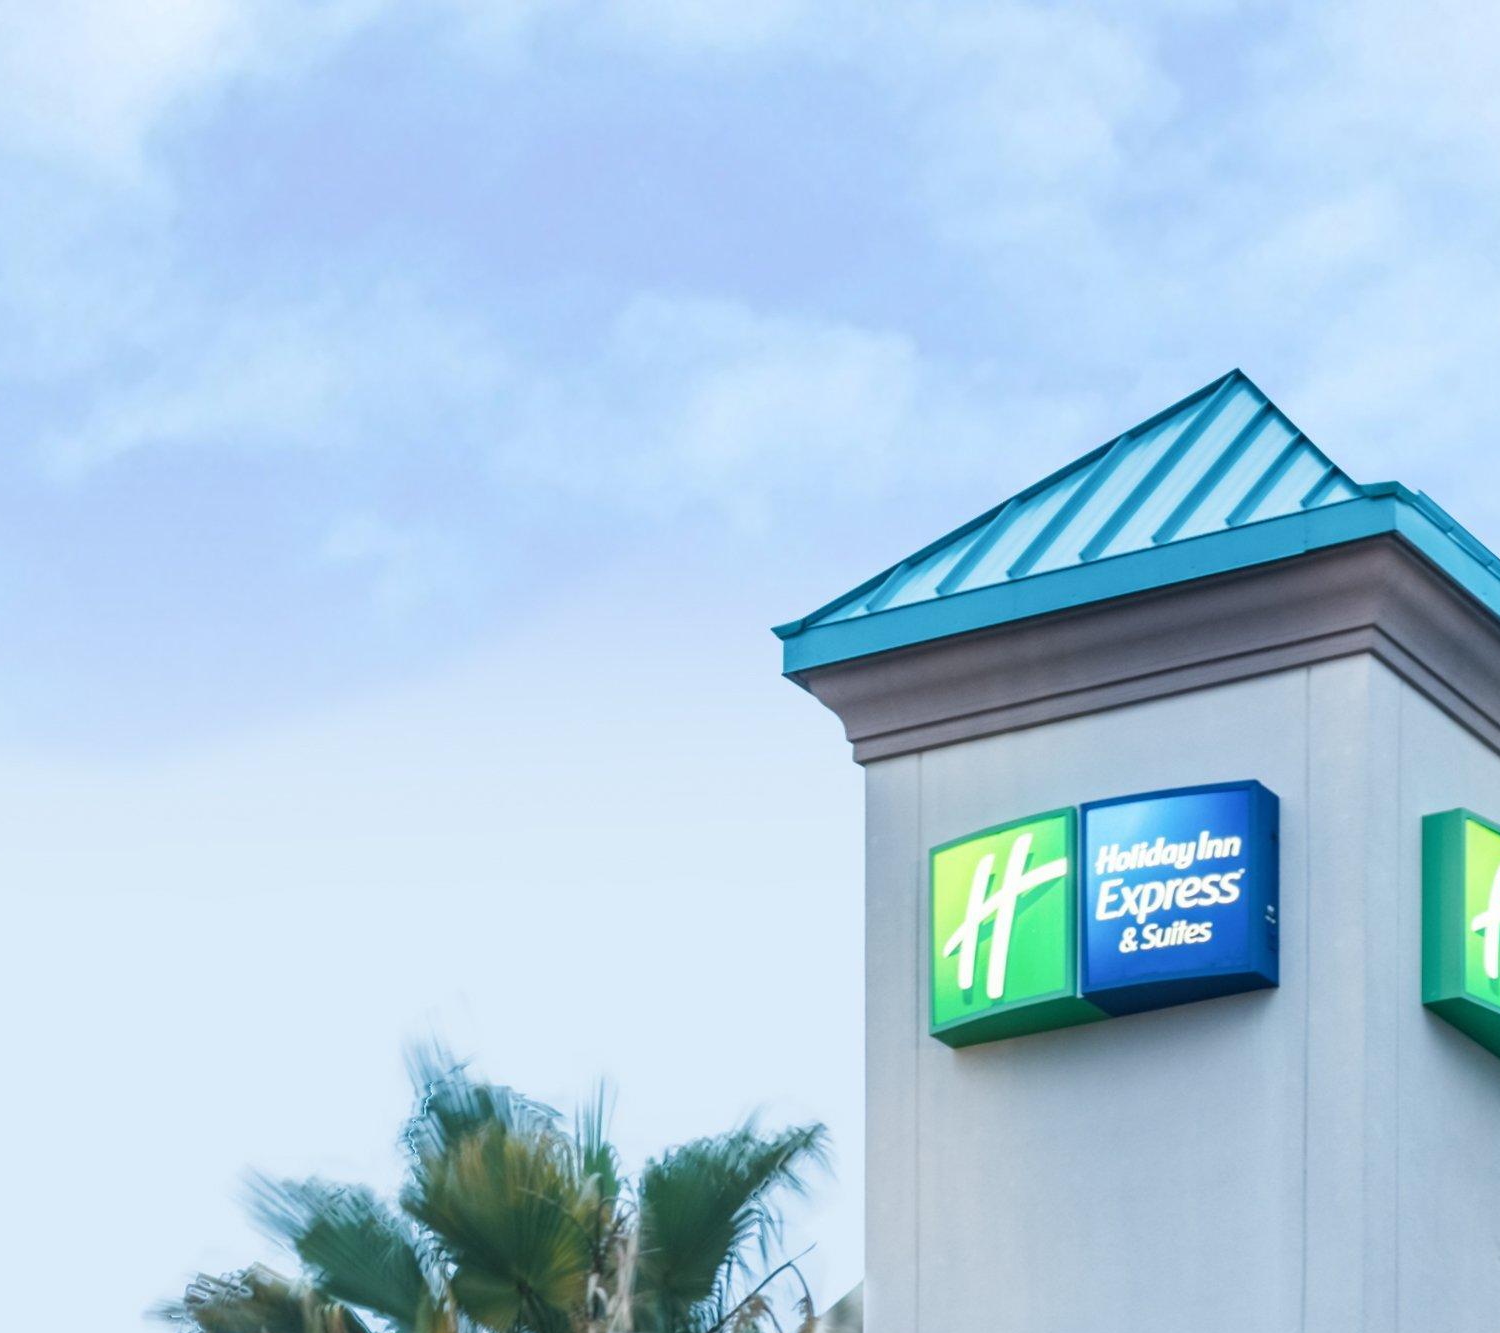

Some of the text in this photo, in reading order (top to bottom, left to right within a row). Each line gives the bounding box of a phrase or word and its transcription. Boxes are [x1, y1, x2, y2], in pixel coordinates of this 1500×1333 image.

[1094, 830, 1242, 876] Holiday Inn
[1095, 870, 1242, 924] Express
[1118, 918, 1213, 953] & Suites
